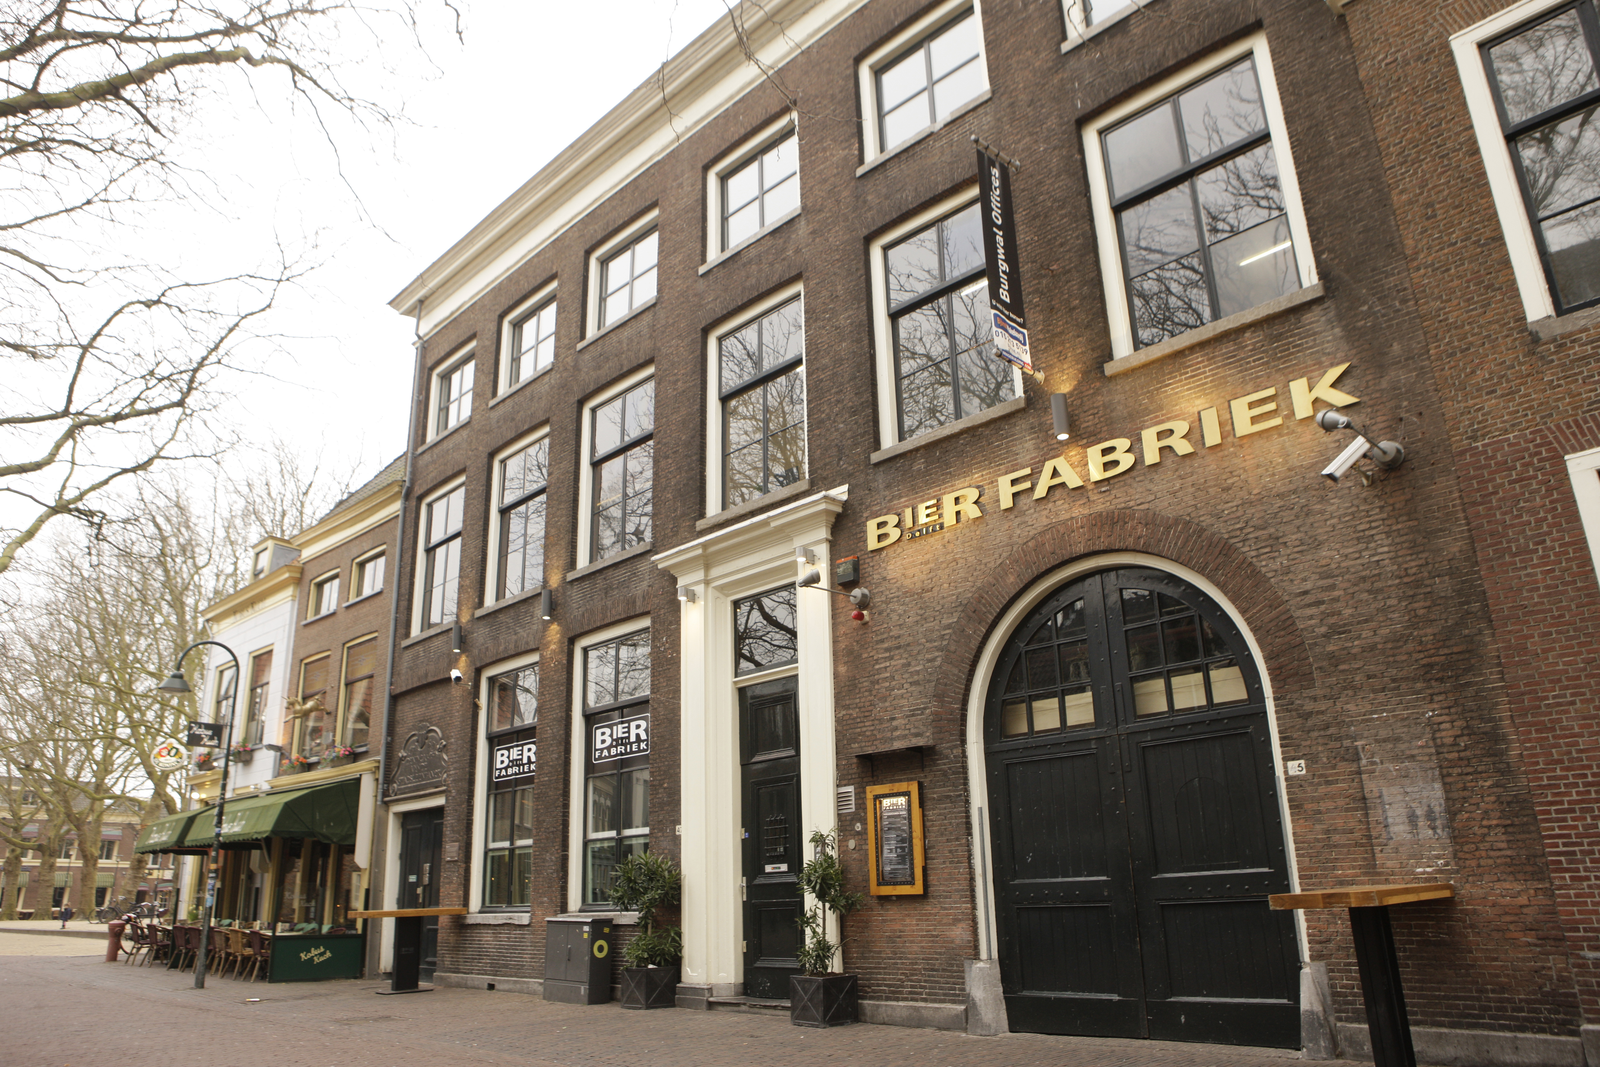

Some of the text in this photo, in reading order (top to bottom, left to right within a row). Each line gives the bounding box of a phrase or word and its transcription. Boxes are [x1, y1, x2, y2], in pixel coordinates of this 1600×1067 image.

[990, 166, 1003, 225] Offices
[993, 227, 1011, 303] Burgwal
[866, 362, 1361, 552] BIER FABRIEK
[906, 524, 940, 540] Delft
[596, 720, 648, 749] BIER
[496, 744, 537, 769] BIER
[595, 741, 648, 759] FABRIEK
[495, 763, 537, 777] FABRIEK
[883, 797, 906, 806] BIER
